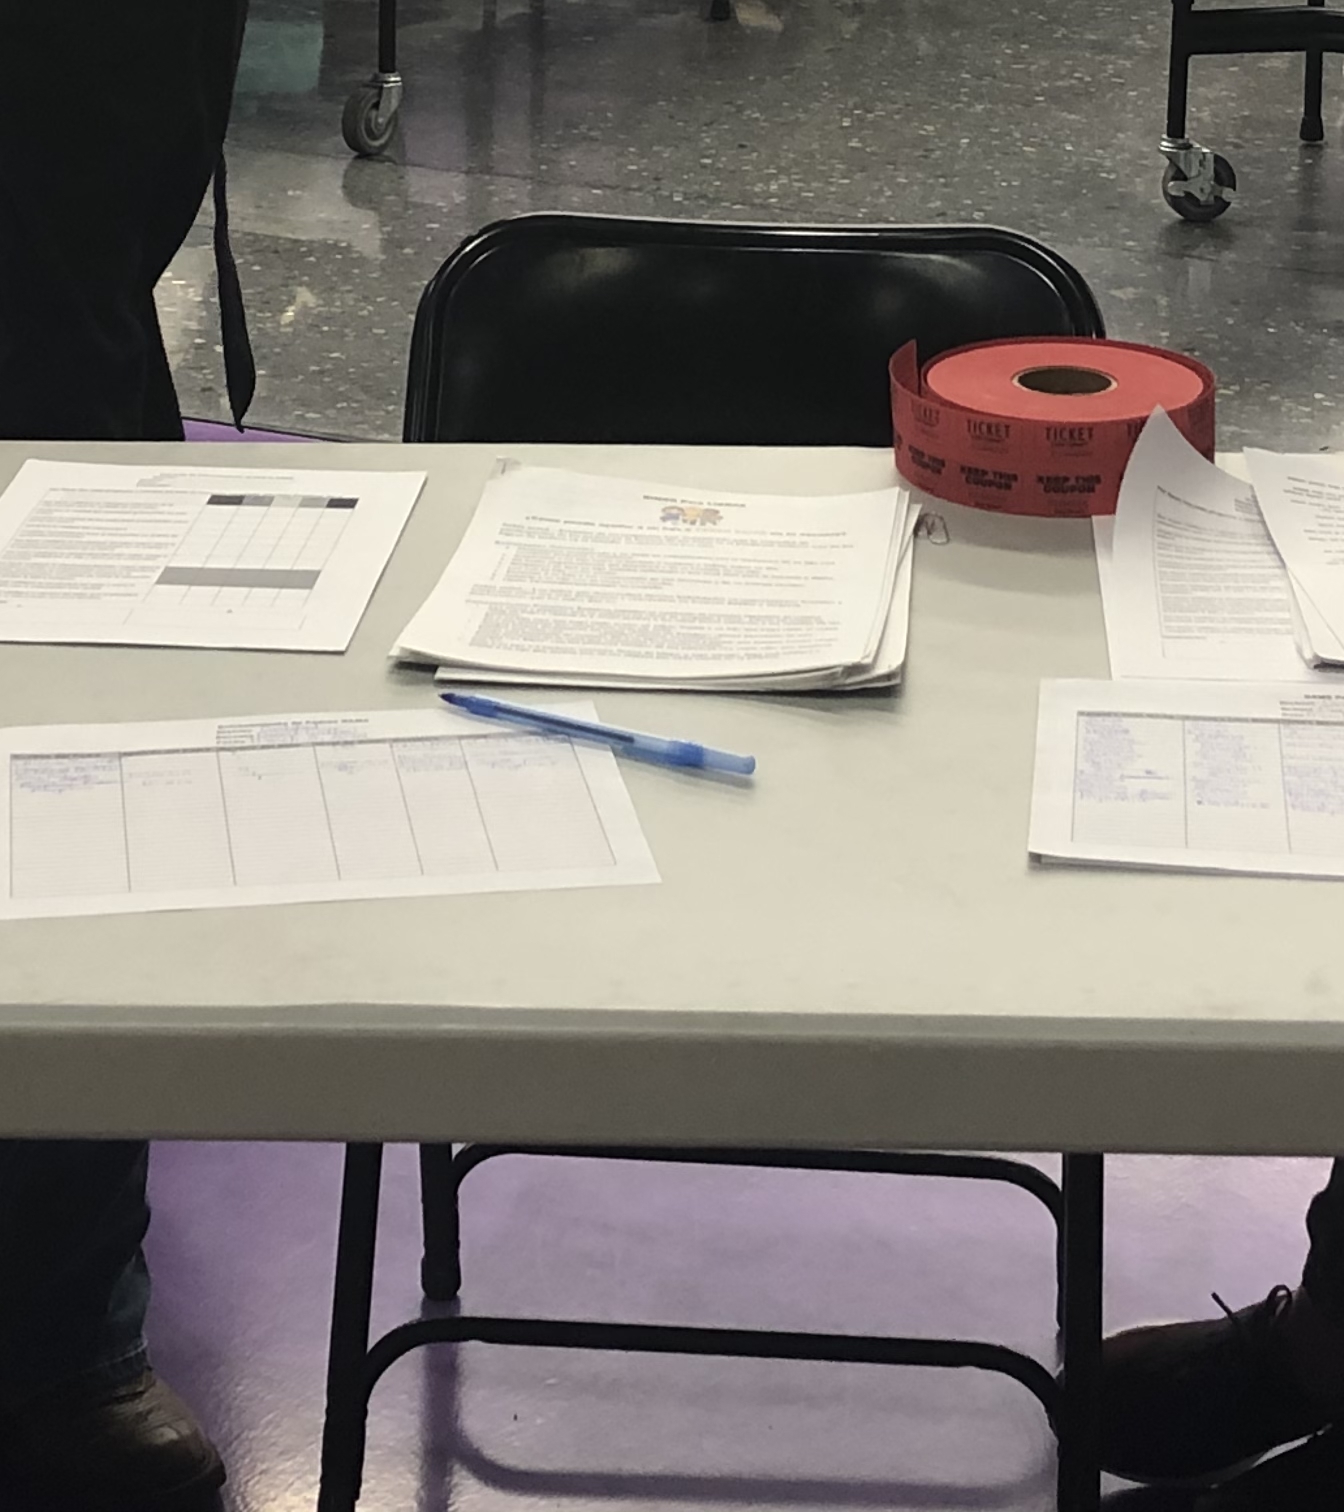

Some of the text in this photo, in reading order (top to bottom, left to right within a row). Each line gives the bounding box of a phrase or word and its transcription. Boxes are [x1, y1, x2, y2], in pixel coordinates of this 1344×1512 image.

[967, 419, 1010, 439] TICKET
[1045, 426, 1094, 441] TICKET
[1037, 474, 1101, 485] KEEP THIS
[1043, 484, 1095, 494] COUPON
